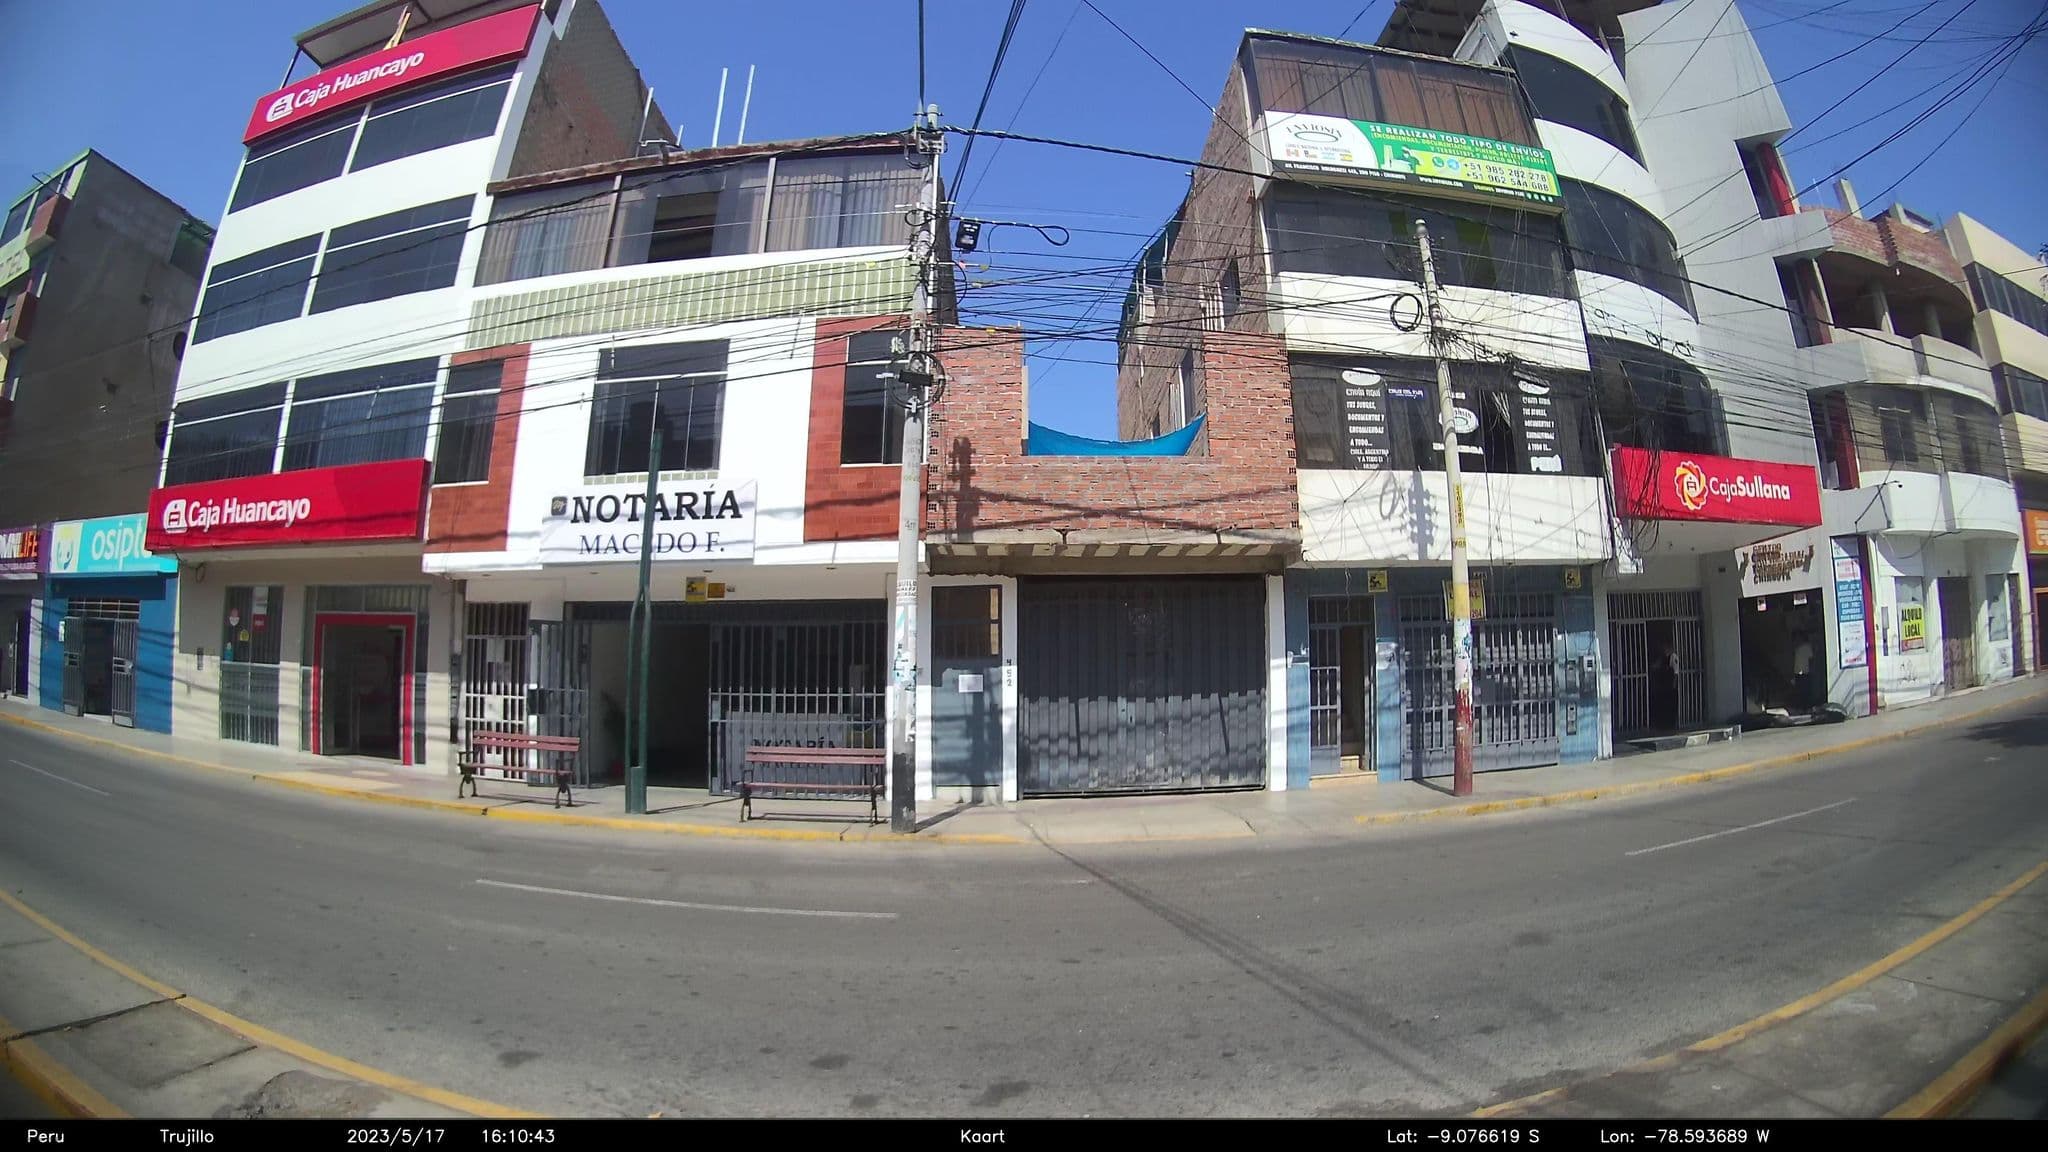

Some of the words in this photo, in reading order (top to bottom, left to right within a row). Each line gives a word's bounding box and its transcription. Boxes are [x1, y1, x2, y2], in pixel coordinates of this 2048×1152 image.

[294, 83, 331, 108] Caja
[331, 52, 425, 94] Huancayo
[1369, 124, 1381, 133] SE
[1386, 127, 1437, 140] REALIZAN
[1440, 134, 1467, 145] TODO
[1469, 139, 1492, 149] TIPO
[1495, 144, 1507, 152] DE
[1463, 162, 1482, 172] +51
[1466, 171, 1484, 181] +51
[1709, 475, 1791, 503] CajaSullana
[187, 499, 220, 533] Caja
[221, 497, 311, 528] Huancayo
[570, 484, 743, 524] NOTARÍA
[579, 531, 697, 555] MACDO
[704, 531, 725, 553] F.
